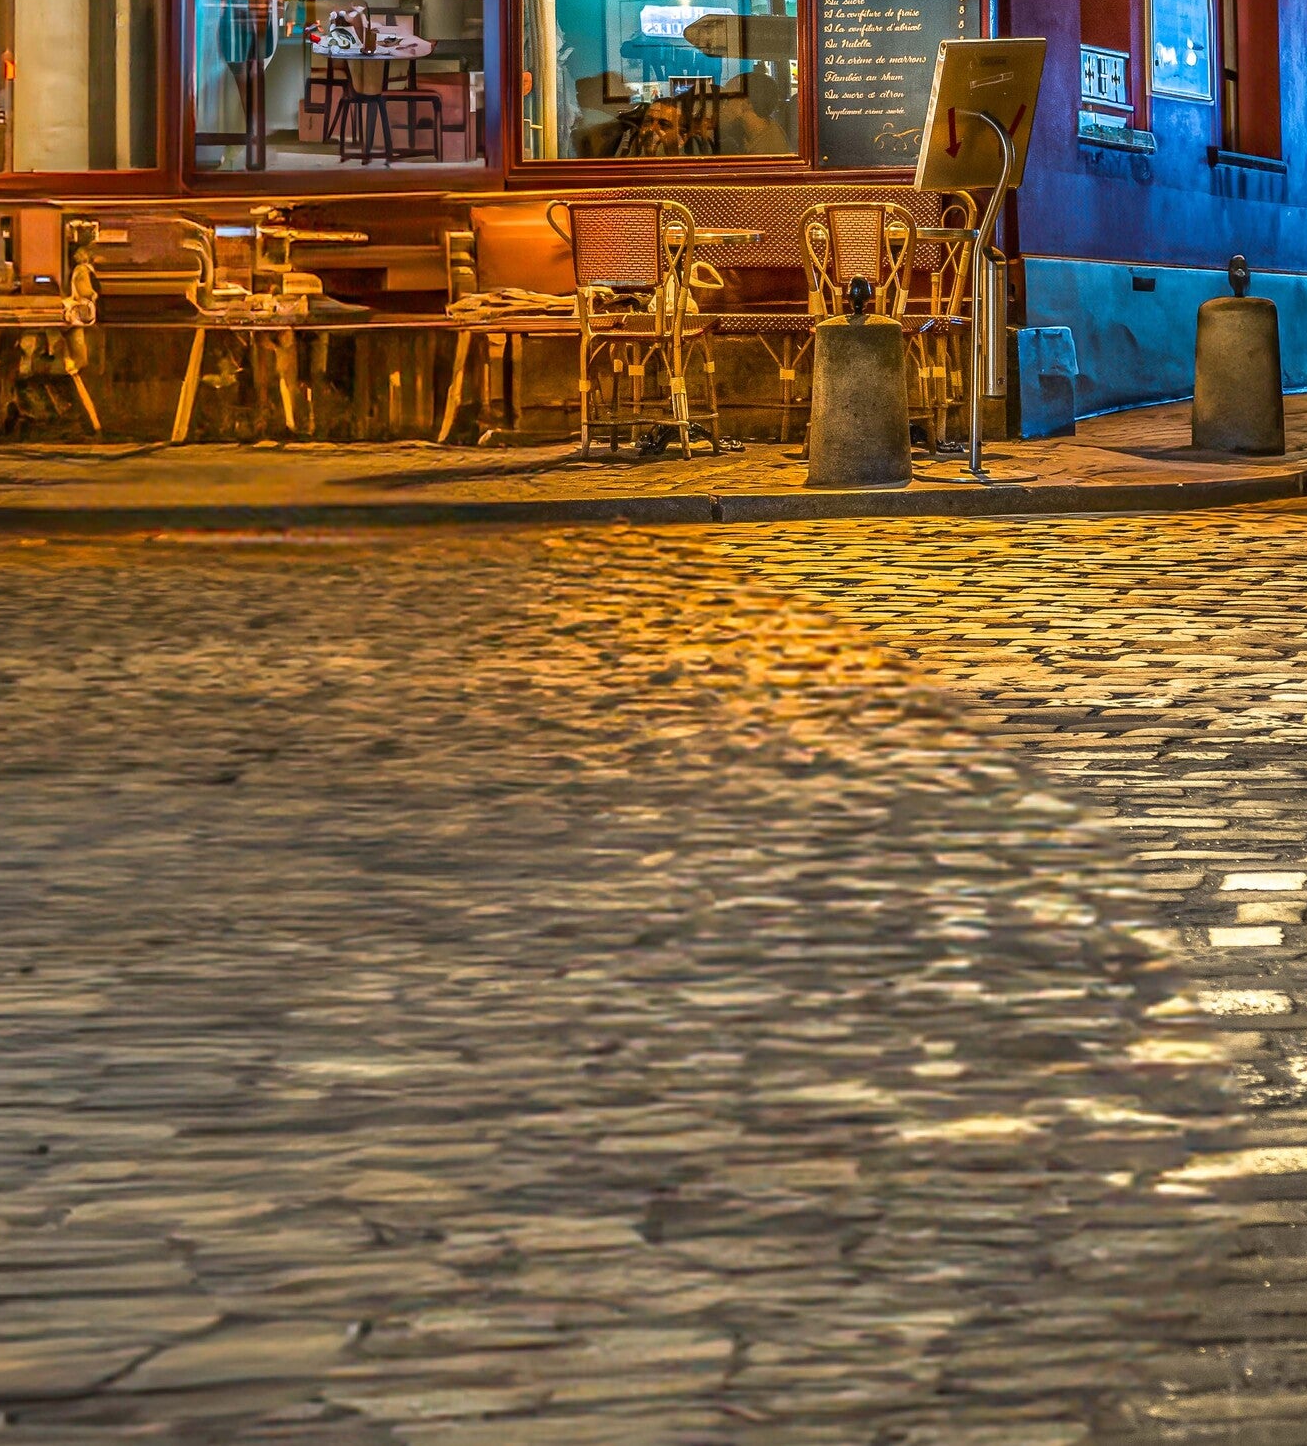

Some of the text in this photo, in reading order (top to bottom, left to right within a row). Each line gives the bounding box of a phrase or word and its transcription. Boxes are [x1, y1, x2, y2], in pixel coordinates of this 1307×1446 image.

[884, 8, 895, 17] de
[896, 8, 920, 22] fraise
[848, 23, 883, 37] confiture
[841, 38, 873, 48] Nutella
[835, 54, 846, 64] la
[847, 55, 873, 65] crème
[875, 55, 886, 64] de
[889, 55, 927, 64] marrons
[824, 70, 863, 83] Flambées
[879, 89, 905, 98] citron
